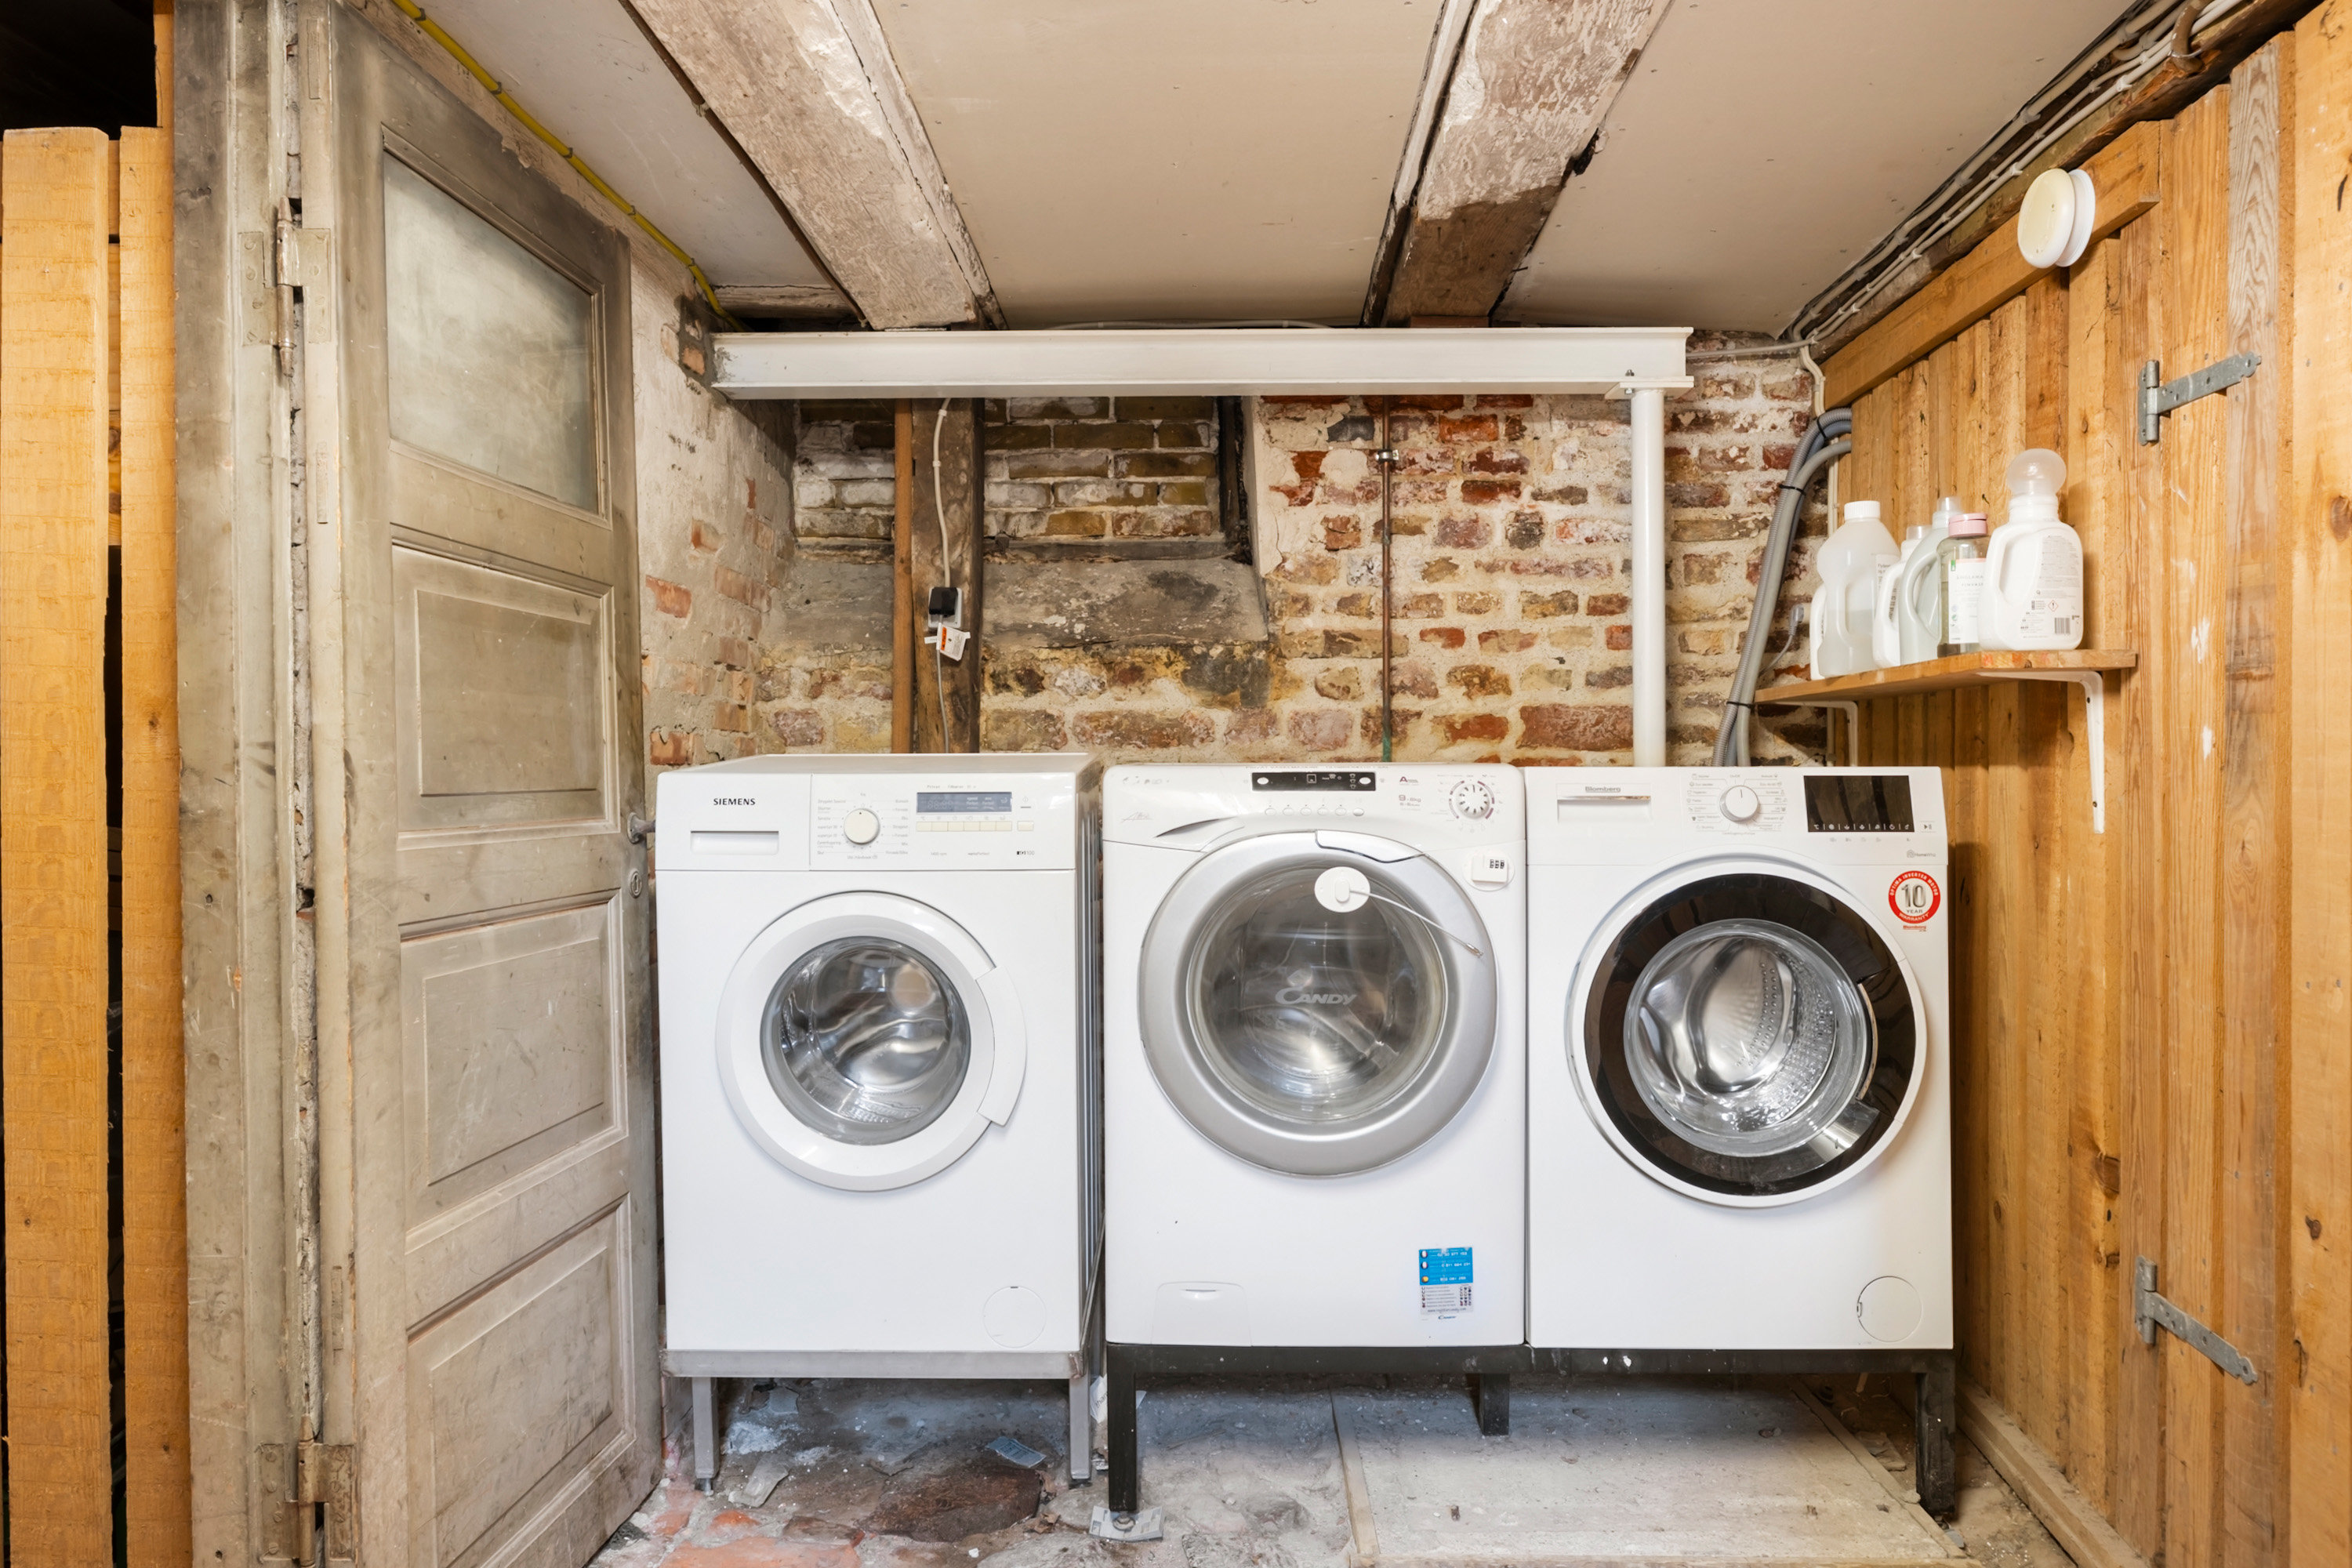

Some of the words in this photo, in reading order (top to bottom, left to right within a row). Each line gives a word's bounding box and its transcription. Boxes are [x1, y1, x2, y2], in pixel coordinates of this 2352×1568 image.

[1889, 877, 1903, 896] OPTIMA
[1927, 878, 1939, 895] MOTOR
[1901, 884, 1926, 908] 10
[1899, 912, 1929, 921] WARRANTY
[1275, 986, 1357, 1005] CANDY
